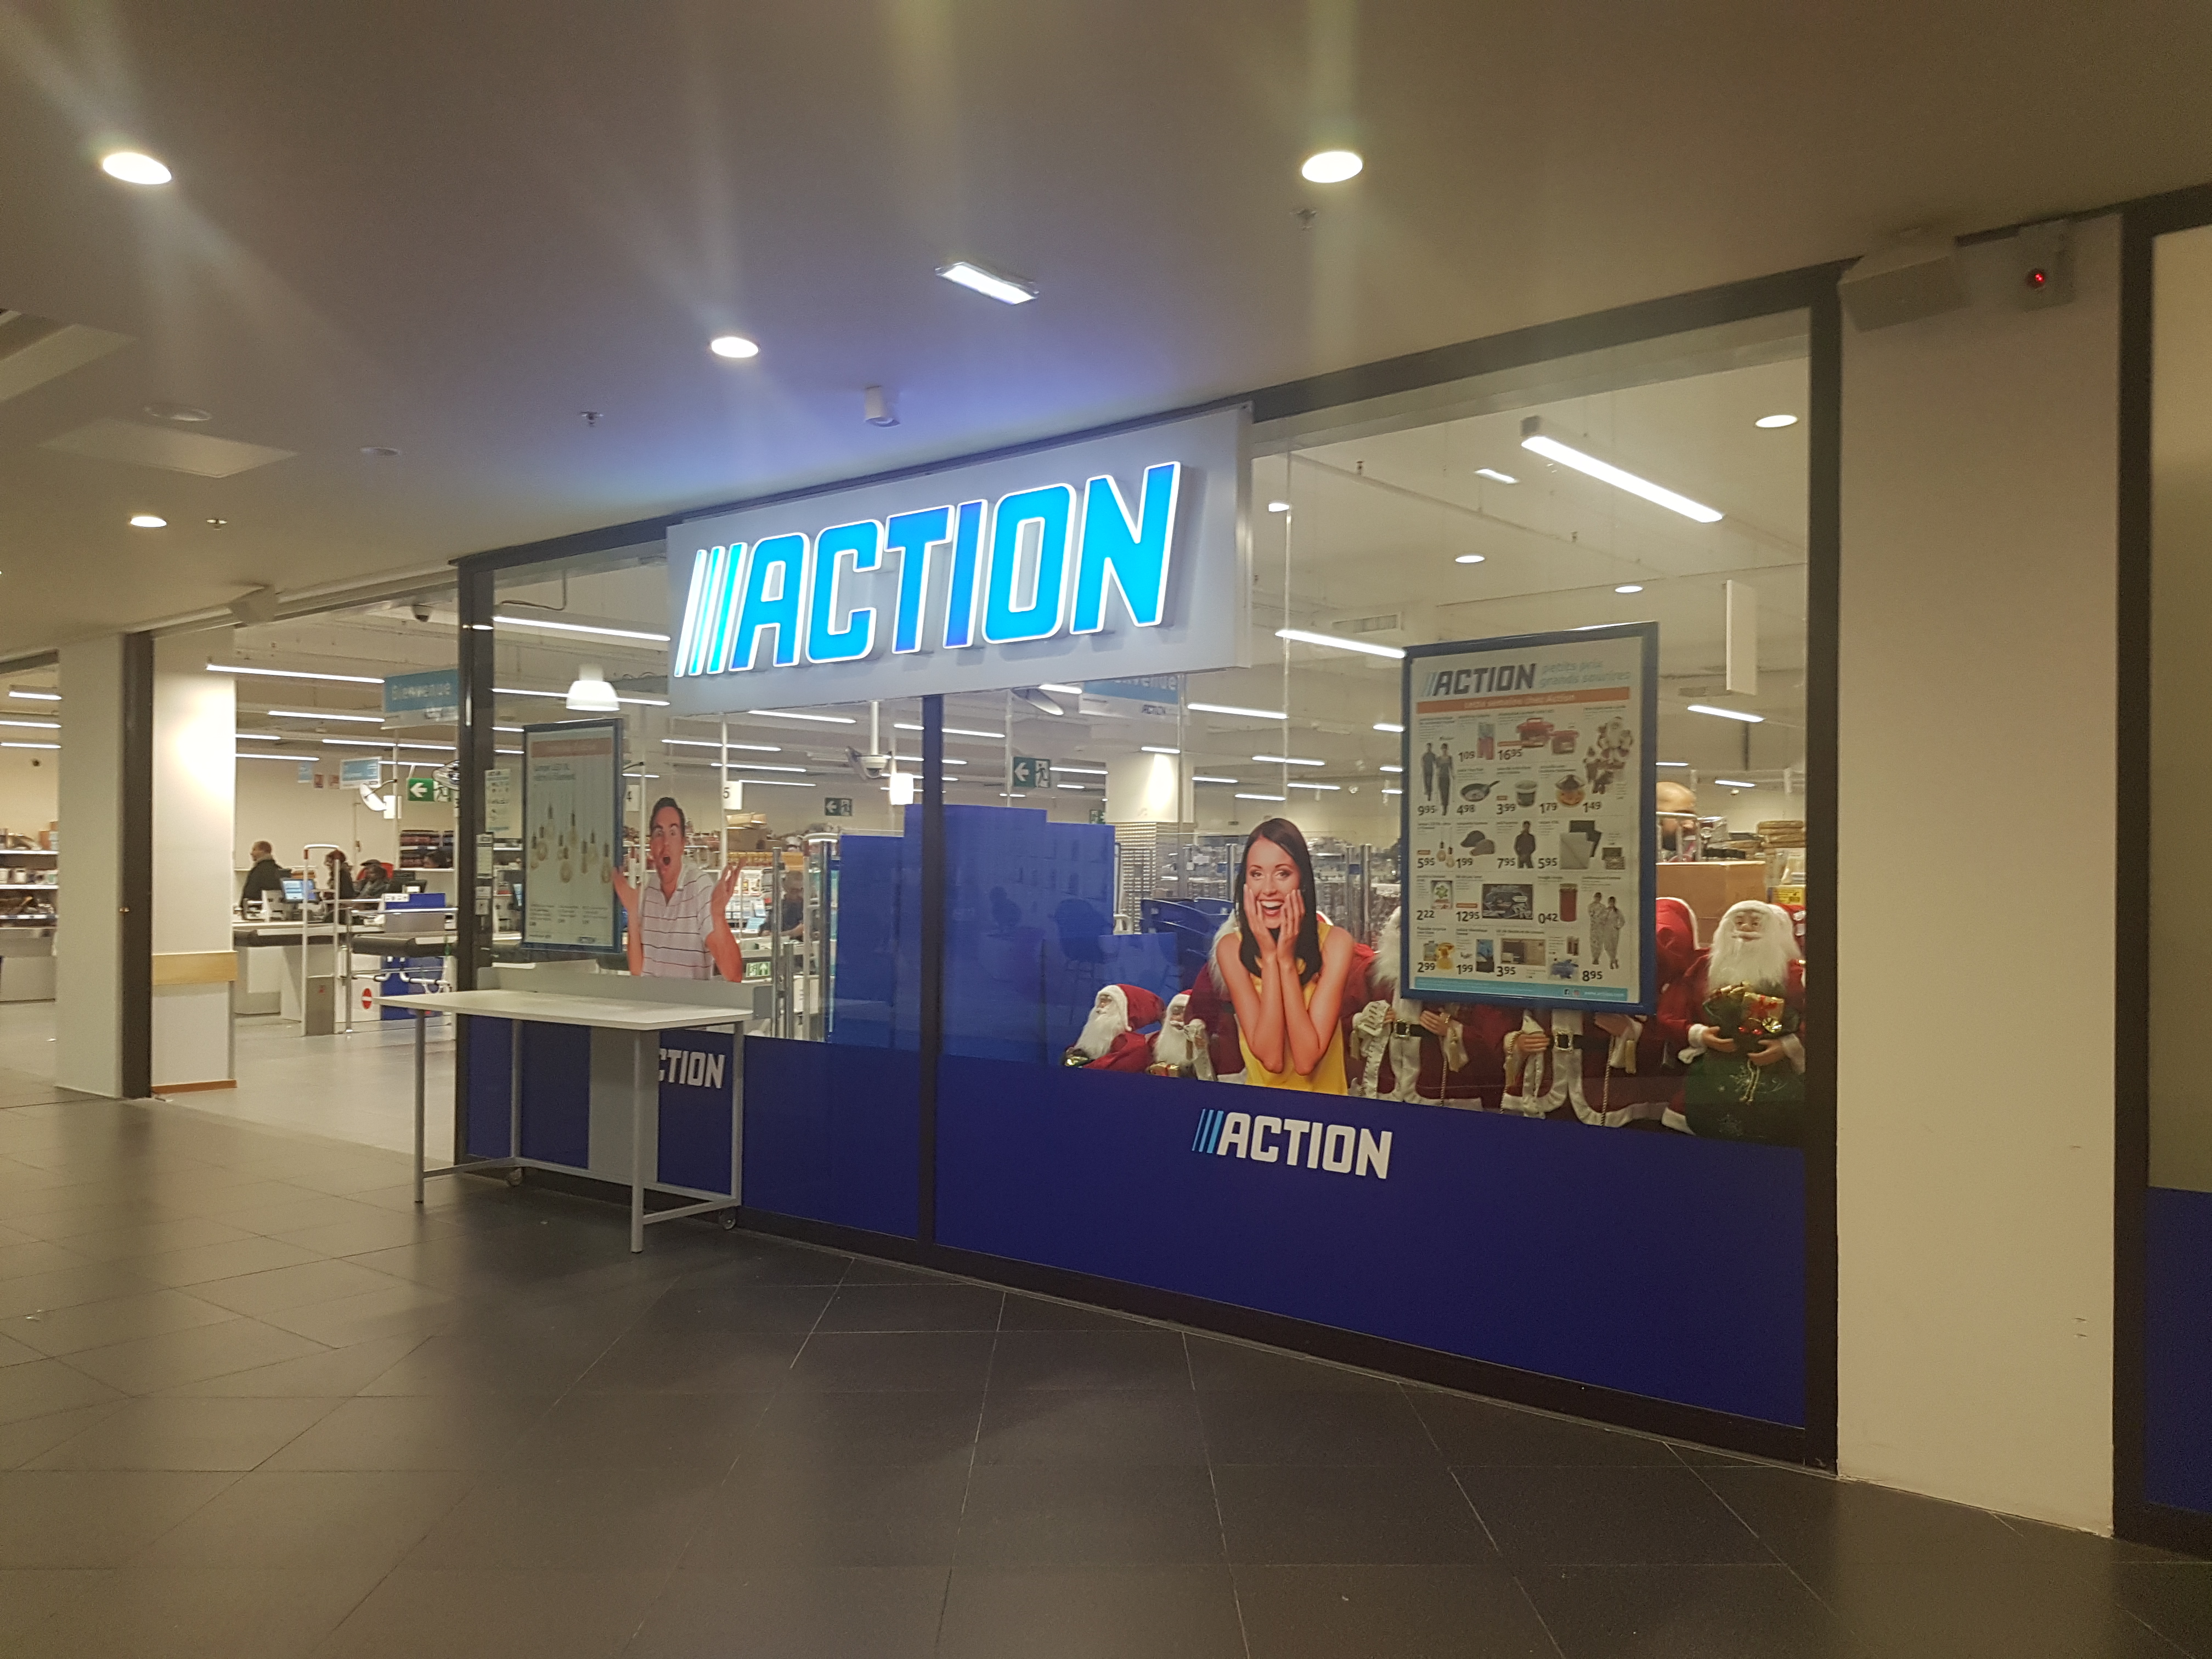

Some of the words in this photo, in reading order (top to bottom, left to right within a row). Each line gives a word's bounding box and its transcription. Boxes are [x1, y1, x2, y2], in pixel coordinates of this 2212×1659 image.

[728, 461, 1181, 672] ACTION
[1432, 663, 1537, 696] ACTION
[723, 787, 730, 799] 5
[1216, 1112, 1393, 1180] ACTION
